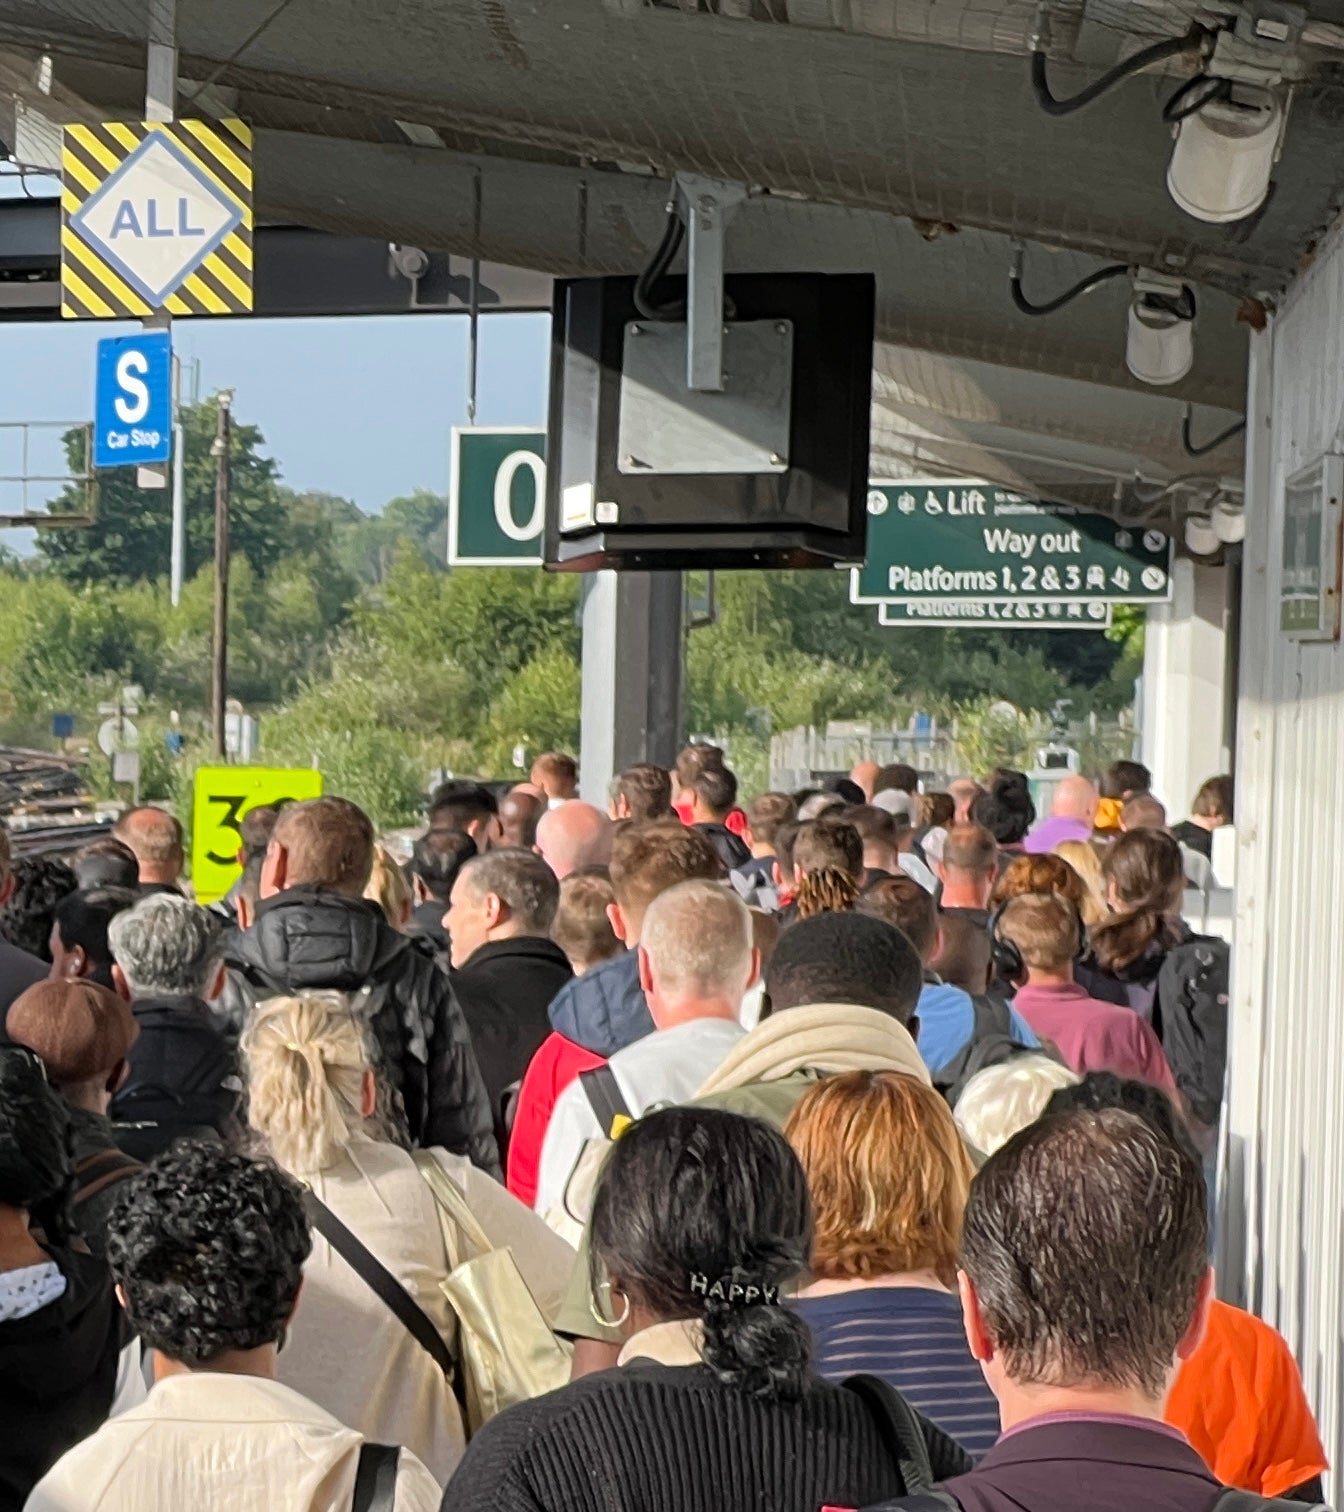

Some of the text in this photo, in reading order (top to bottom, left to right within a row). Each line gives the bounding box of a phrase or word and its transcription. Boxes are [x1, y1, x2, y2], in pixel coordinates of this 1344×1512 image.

[109, 198, 205, 239] ALL
[115, 350, 149, 424] S
[107, 428, 160, 449] Car Stop
[948, 489, 986, 515] Lift
[983, 528, 1081, 558] Way out
[889, 565, 1080, 593] Platforms 1, 2 & 3
